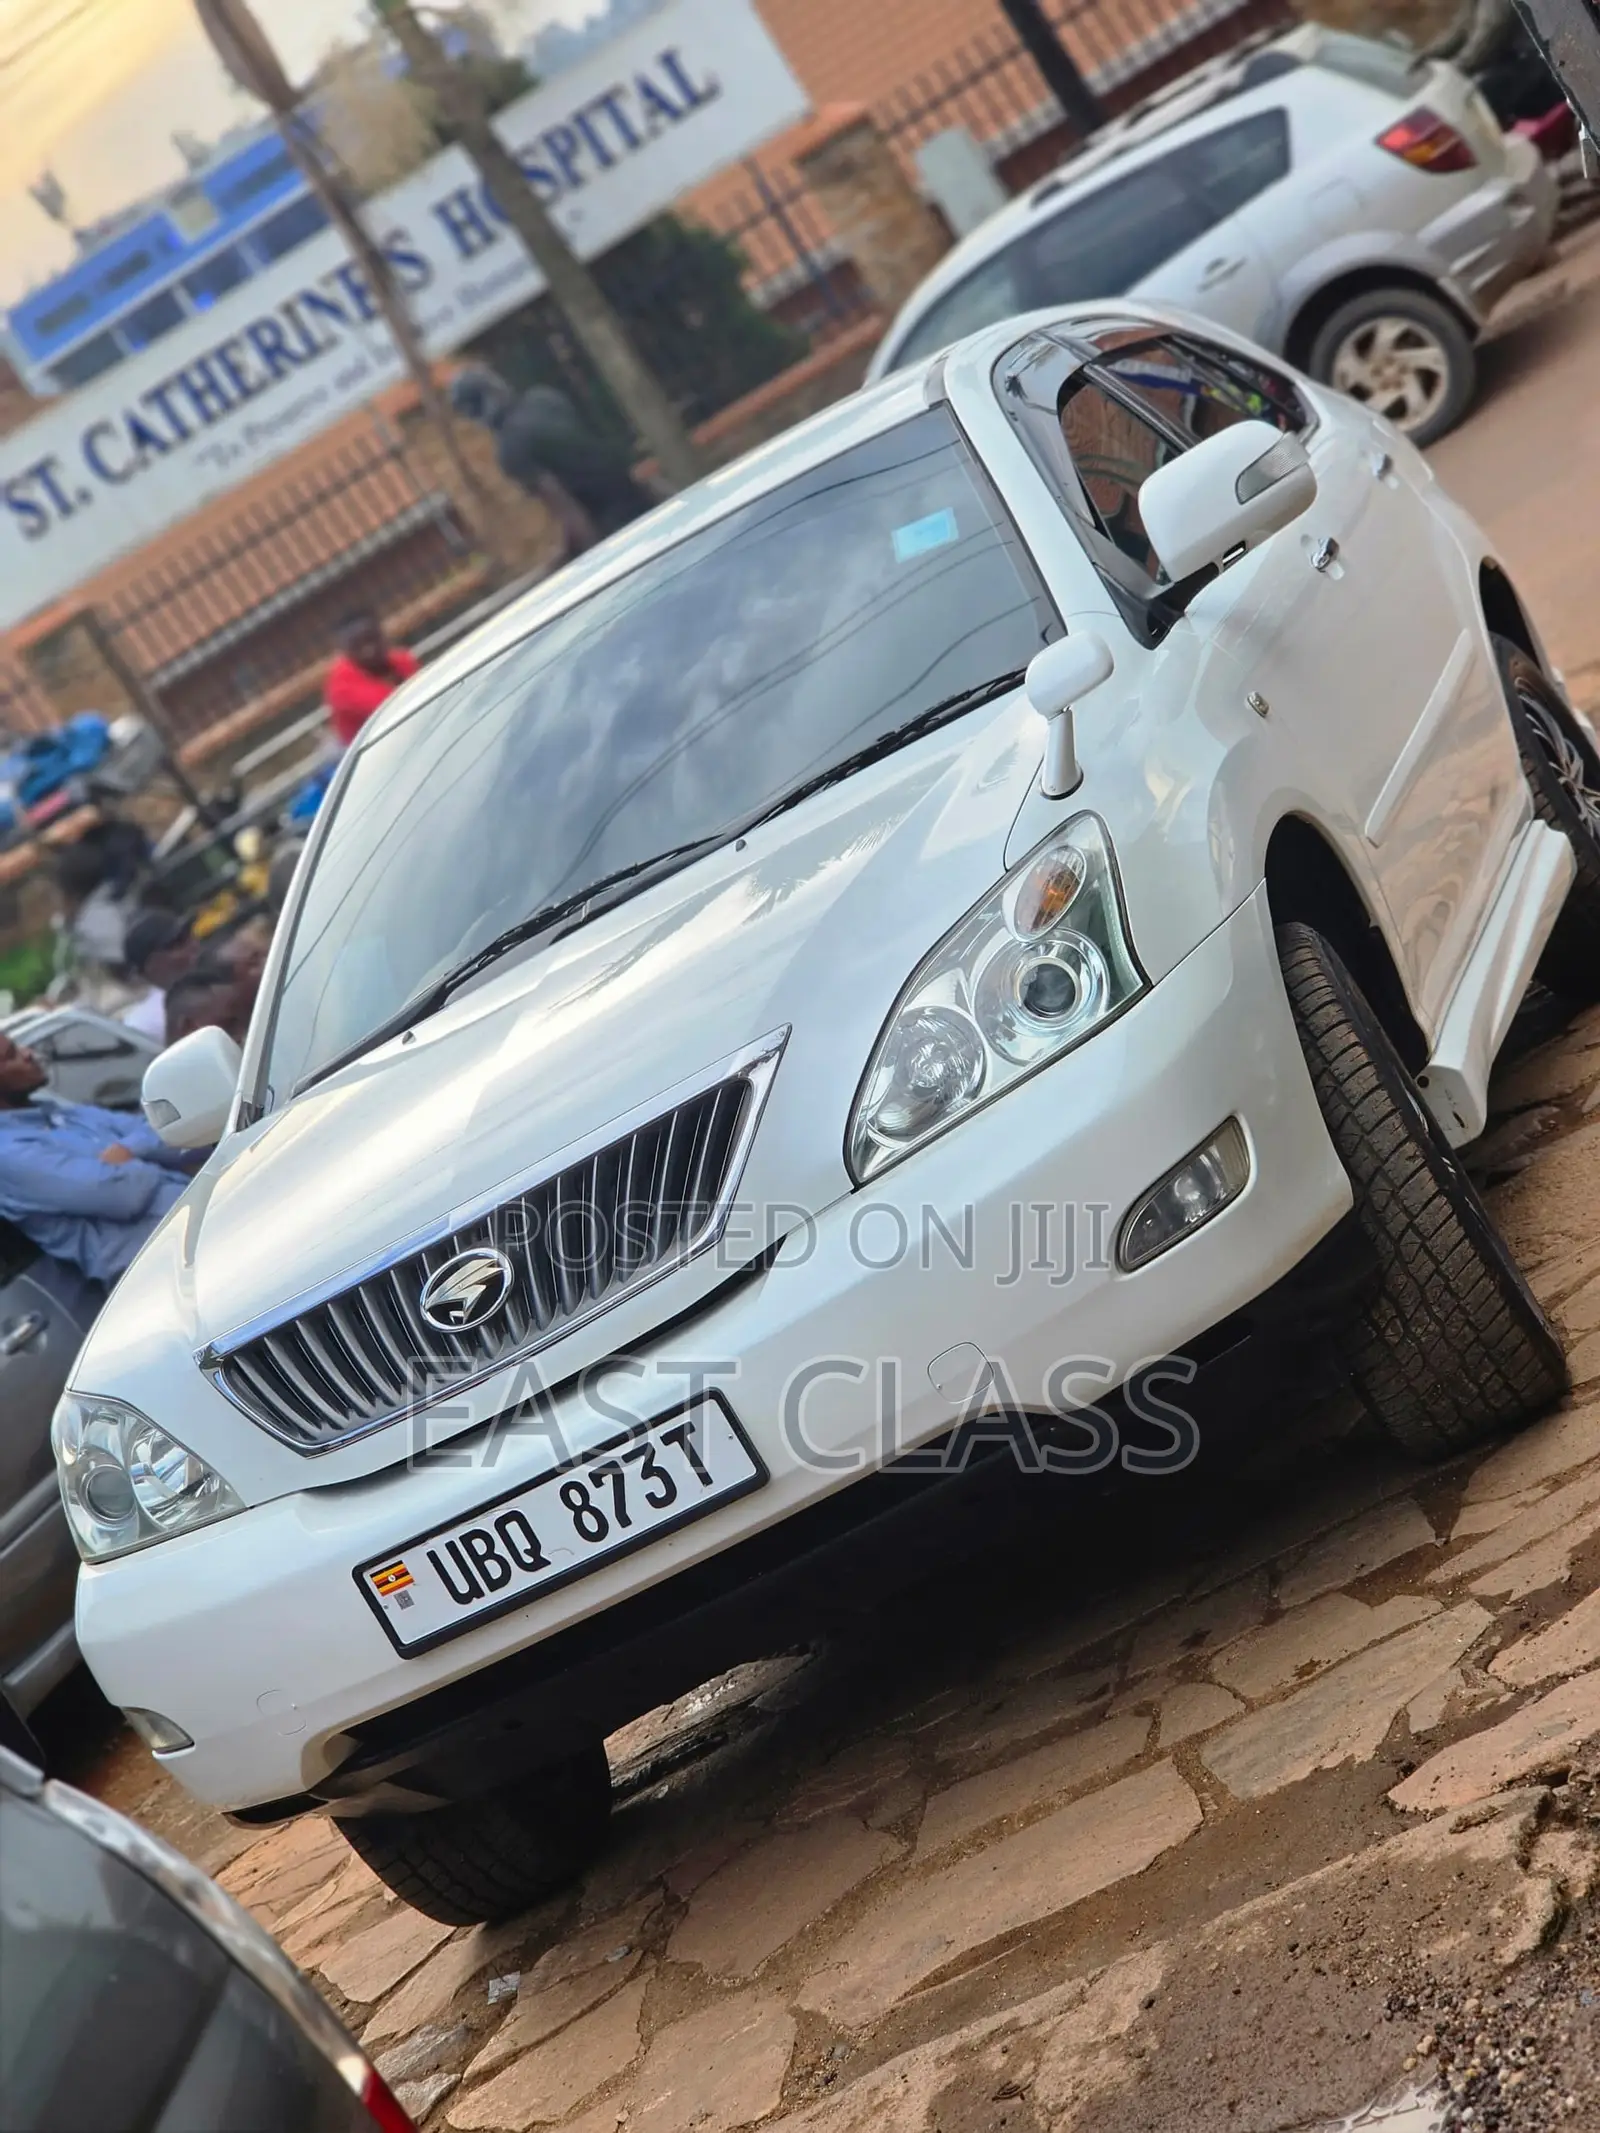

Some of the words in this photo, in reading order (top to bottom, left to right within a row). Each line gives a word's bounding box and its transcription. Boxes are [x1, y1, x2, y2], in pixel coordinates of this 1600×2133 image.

[2, 454, 93, 541] ST.
[426, 1509, 551, 1605] UBQ
[559, 1420, 714, 1543] 873T
